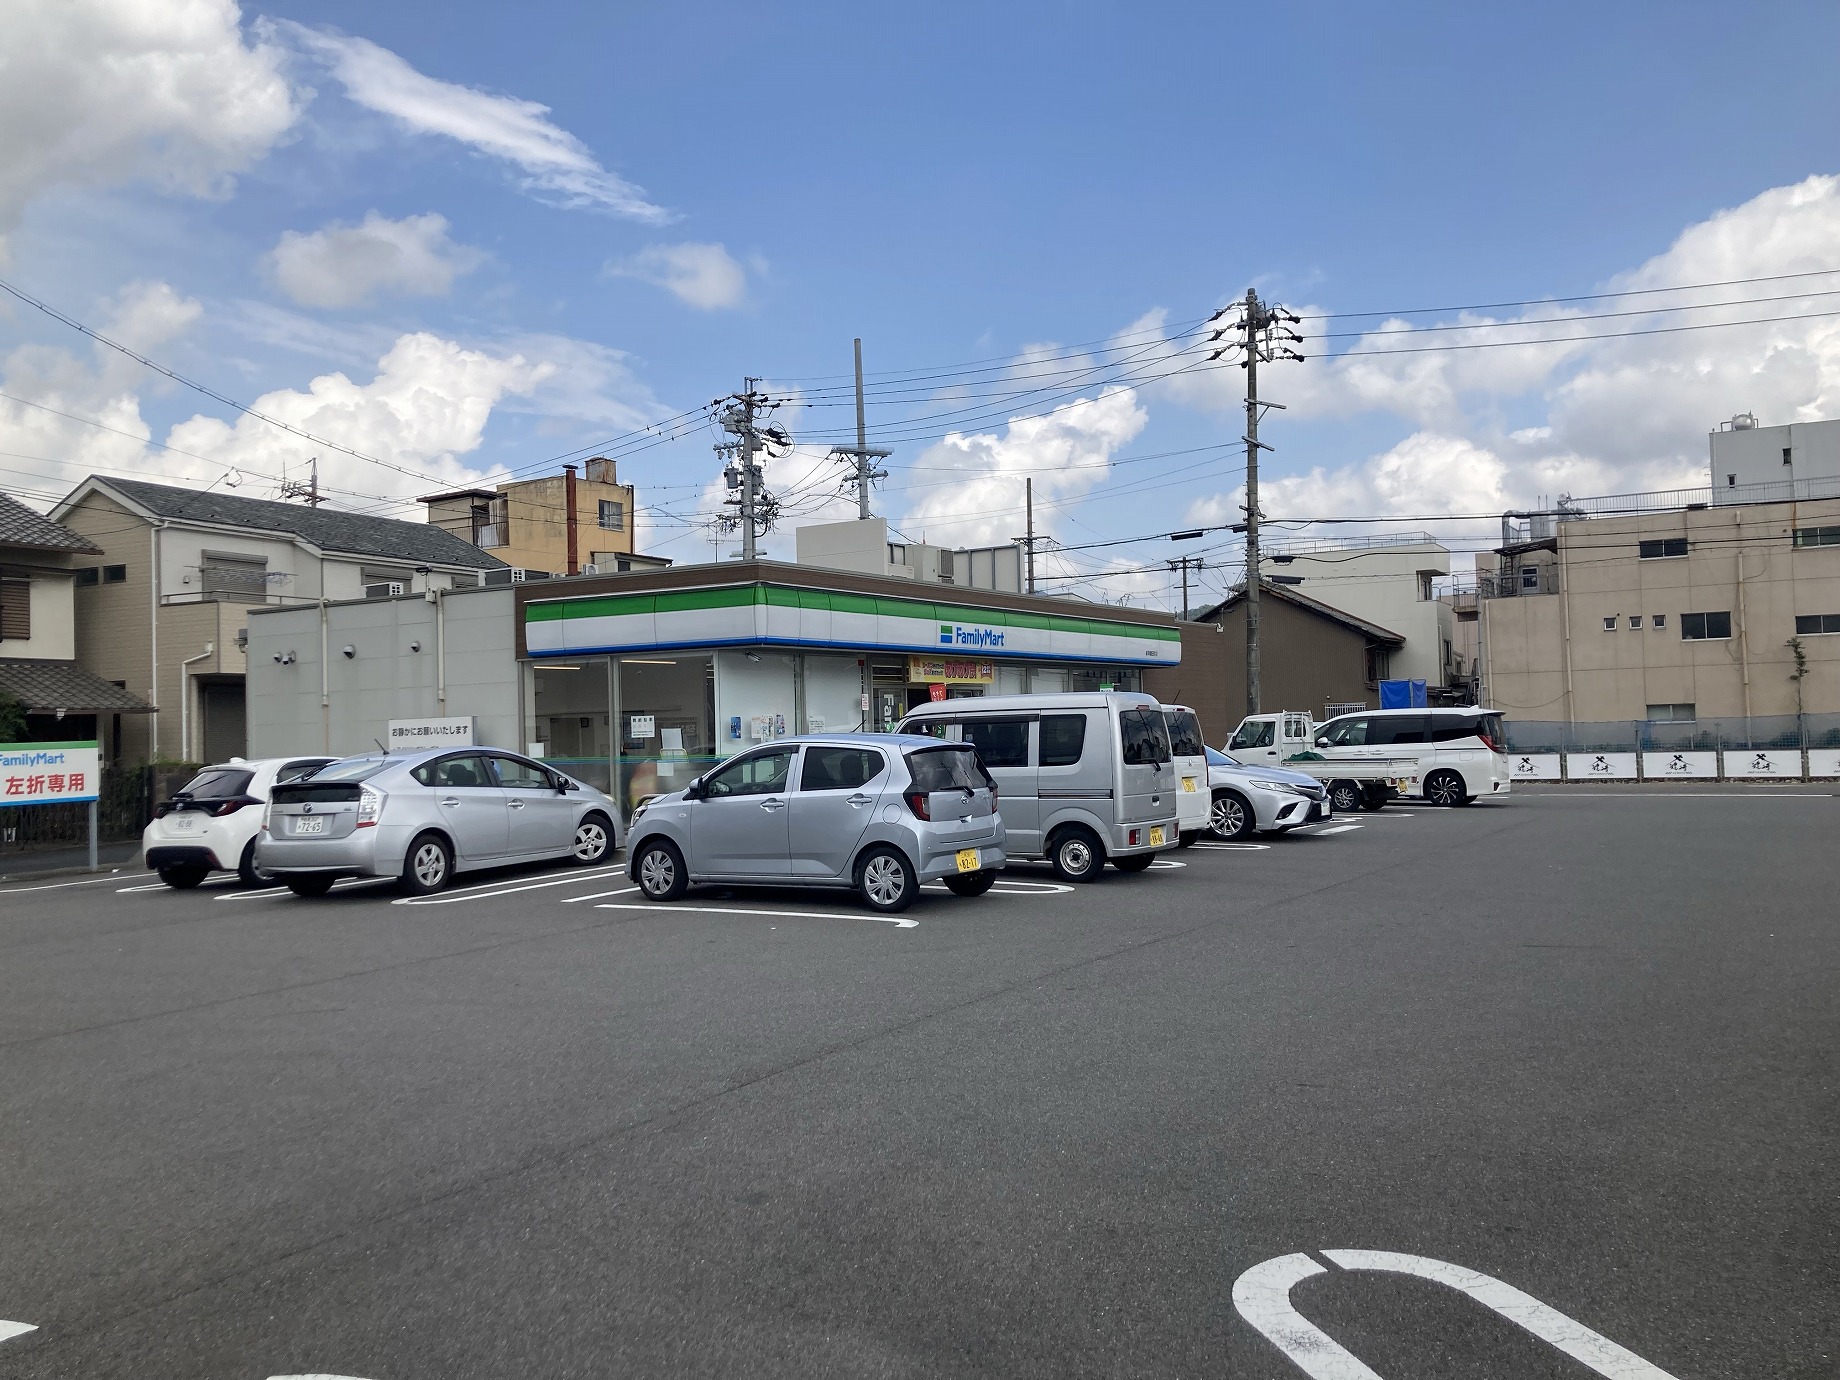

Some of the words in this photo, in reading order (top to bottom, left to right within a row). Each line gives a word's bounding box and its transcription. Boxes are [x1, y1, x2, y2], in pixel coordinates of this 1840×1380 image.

[956, 627, 1004, 647] FamilyMart
[392, 725, 468, 737] お静かにお願いいたします
[5, 773, 84, 796] 左折専用
